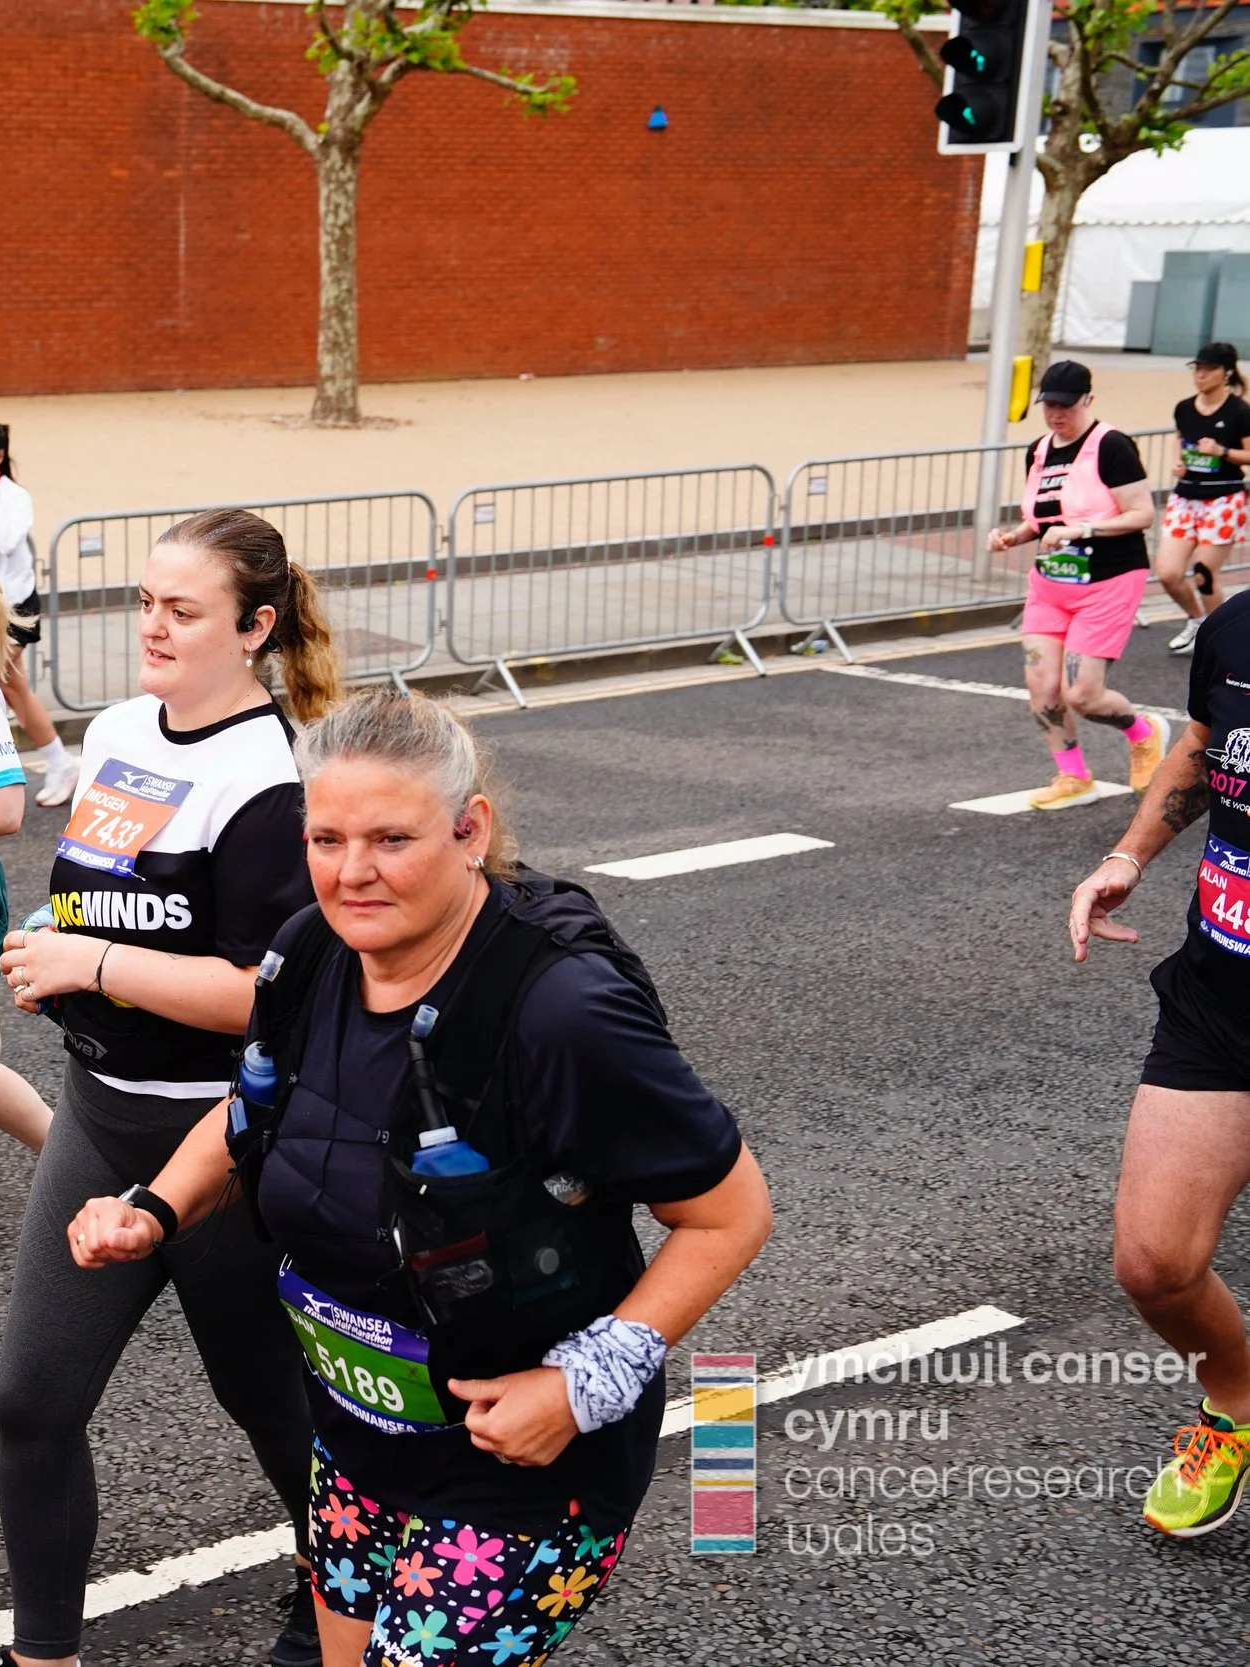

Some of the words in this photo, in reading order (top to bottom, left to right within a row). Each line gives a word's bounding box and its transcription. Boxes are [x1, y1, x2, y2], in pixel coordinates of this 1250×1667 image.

[1209, 769, 1247, 798] 2017
[85, 788, 130, 813] IMOGEN
[1220, 796, 1231, 808] THE
[81, 808, 144, 849] 7433
[1200, 866, 1228, 891] ALAN
[287, 1308, 317, 1338] SAM
[333, 1306, 393, 1336] SWANSEA
[334, 1318, 352, 1332] Half
[351, 1325, 393, 1346] Marathon
[315, 1342, 405, 1413] 5189
